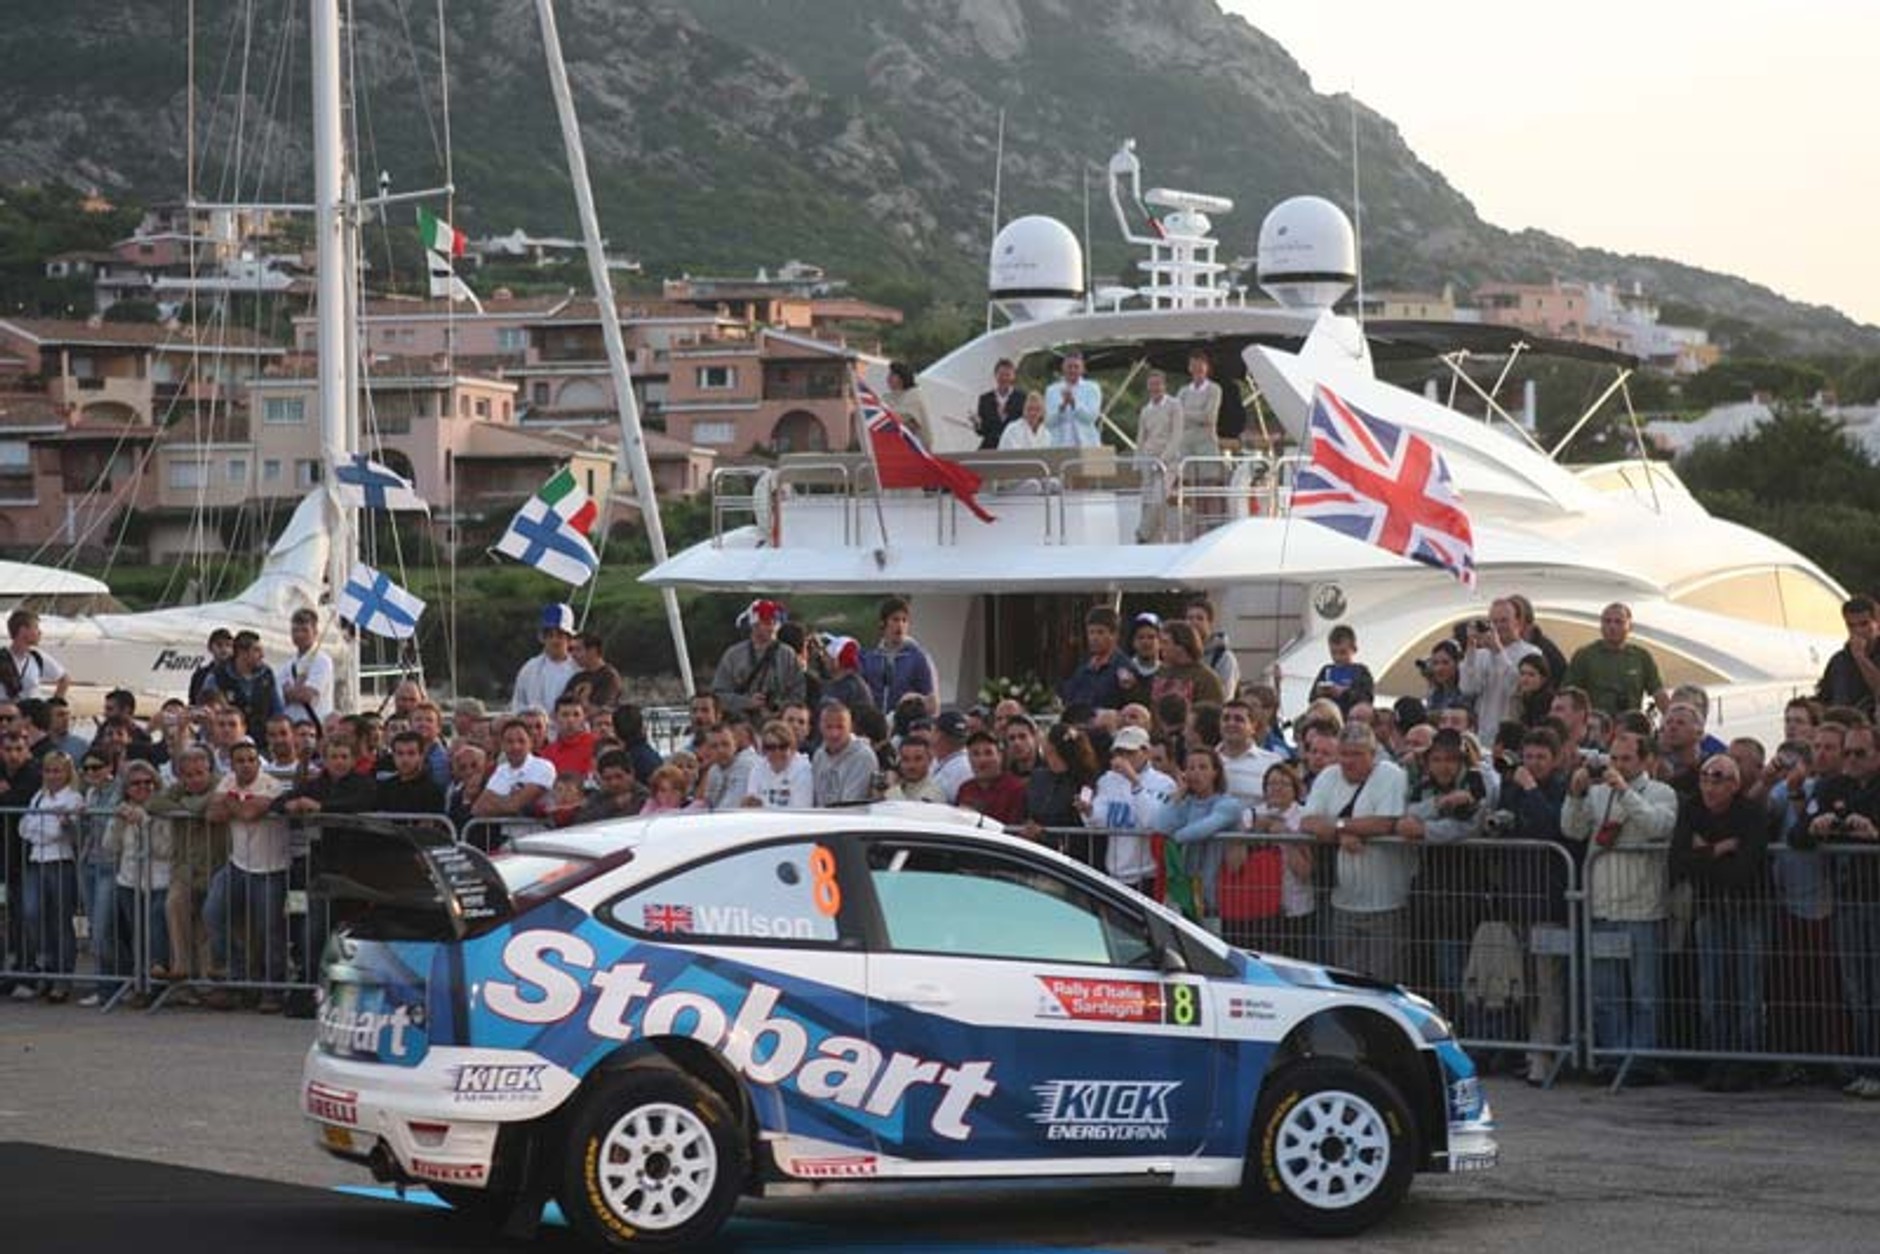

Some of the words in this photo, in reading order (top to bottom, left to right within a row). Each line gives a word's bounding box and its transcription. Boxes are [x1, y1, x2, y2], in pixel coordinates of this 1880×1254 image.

[808, 845, 841, 916] 8
[699, 903, 812, 938] Wilson
[1052, 981, 1089, 1000] Rally
[1092, 983, 1143, 999] d'Italia
[1070, 997, 1144, 1018] Sardegna
[1173, 985, 1194, 1025] 8
[483, 928, 997, 1141] Stobart
[456, 1064, 548, 1092] KICK
[1045, 1080, 1182, 1123] KICK
